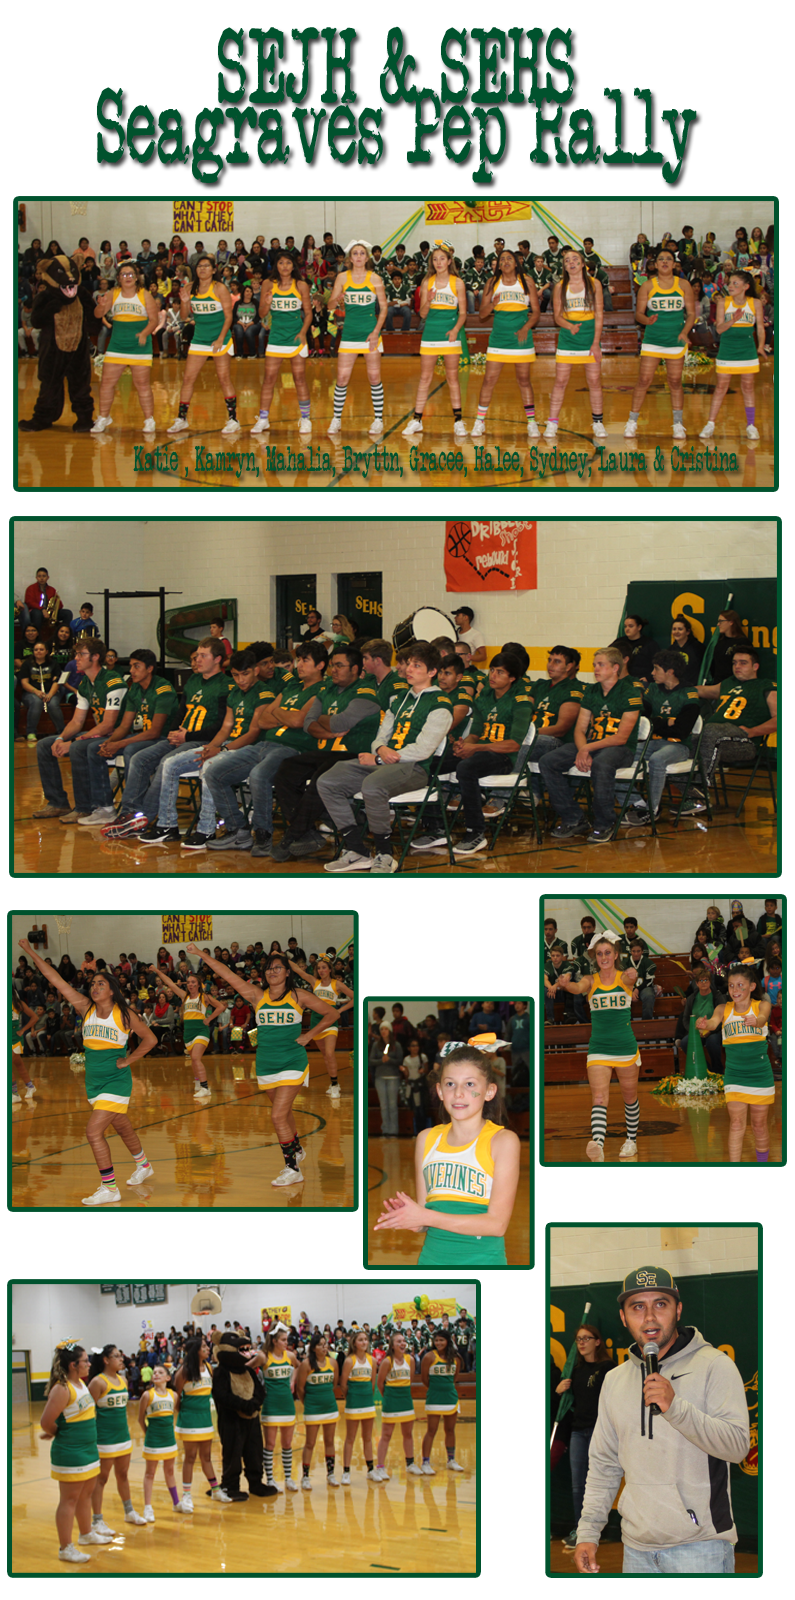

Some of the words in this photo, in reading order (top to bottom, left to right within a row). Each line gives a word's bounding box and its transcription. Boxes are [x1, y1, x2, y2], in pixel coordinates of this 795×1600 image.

[206, 201, 233, 211] STOP
[173, 211, 201, 220] WHAT
[206, 211, 234, 220] THEY
[205, 220, 234, 232] CATCH
[651, 299, 683, 309] SEHS
[107, 697, 120, 706] 12
[162, 923, 186, 932] WHAT
[189, 922, 213, 931] THEY
[188, 931, 213, 941] CATCH
[592, 996, 626, 1009] SEHS
[259, 1012, 295, 1024] SEHS
